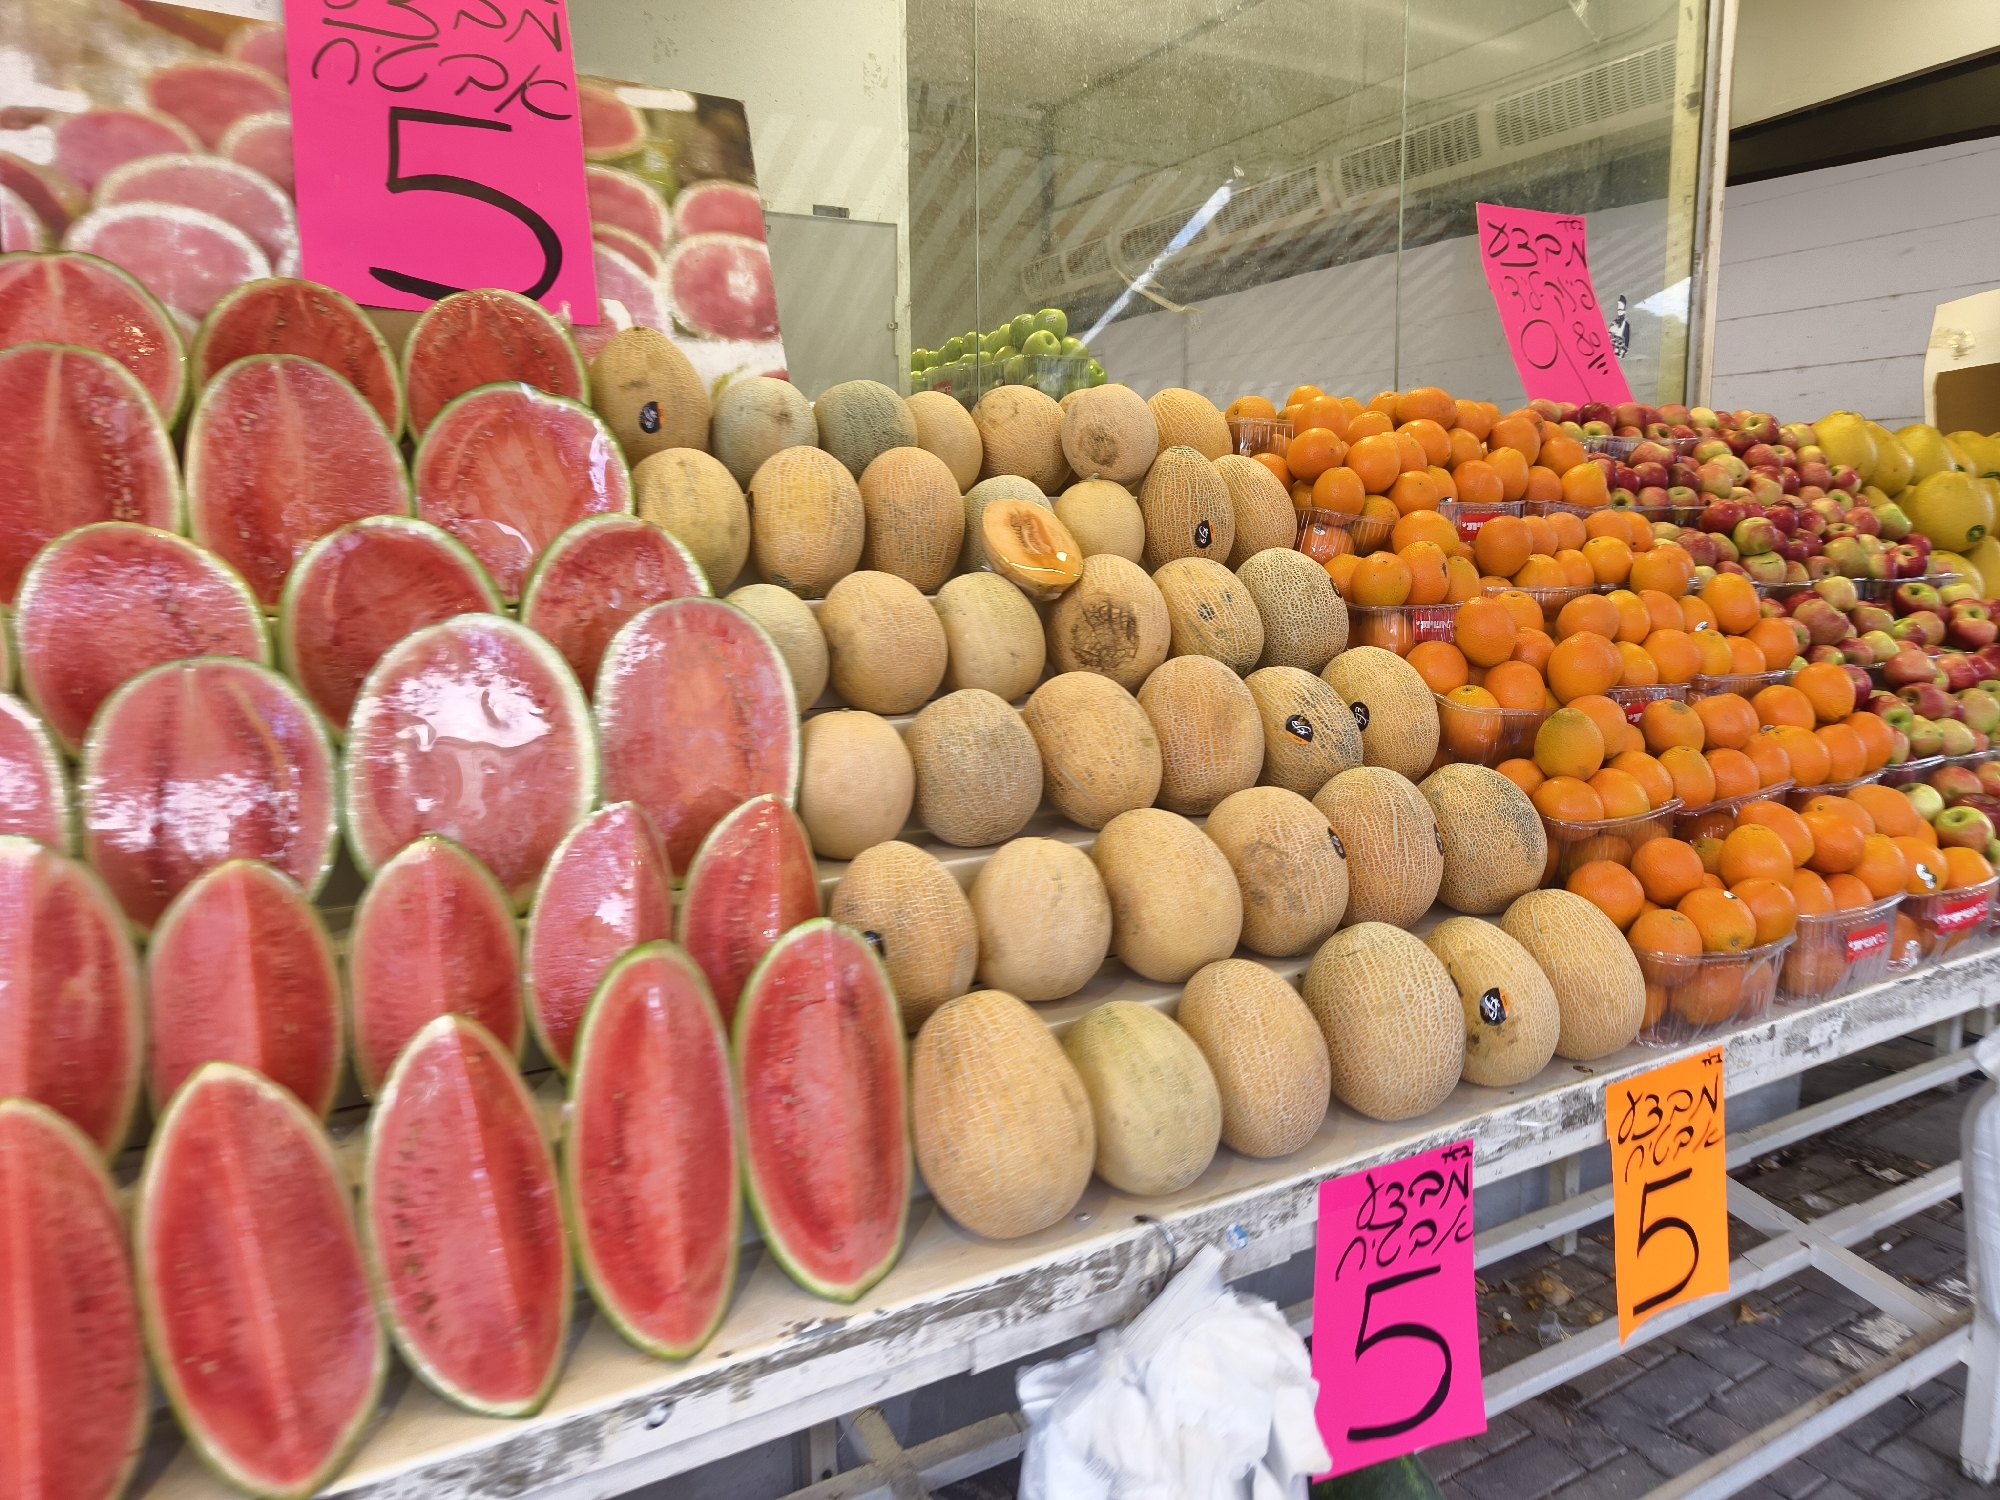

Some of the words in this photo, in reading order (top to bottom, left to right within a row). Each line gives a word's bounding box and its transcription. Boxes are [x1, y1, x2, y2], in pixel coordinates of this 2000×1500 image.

[311, 37, 573, 121] אבטיח
[368, 106, 563, 302] 5
[1487, 219, 1588, 270] מבצע
[1617, 1073, 1719, 1146] מבצע
[1624, 1117, 1724, 1183] אבטיח
[1356, 1161, 1470, 1231] מבצע
[1335, 1204, 1474, 1283] אבטיח
[1632, 1167, 1700, 1317] 5
[1346, 1264, 1453, 1443] 5
